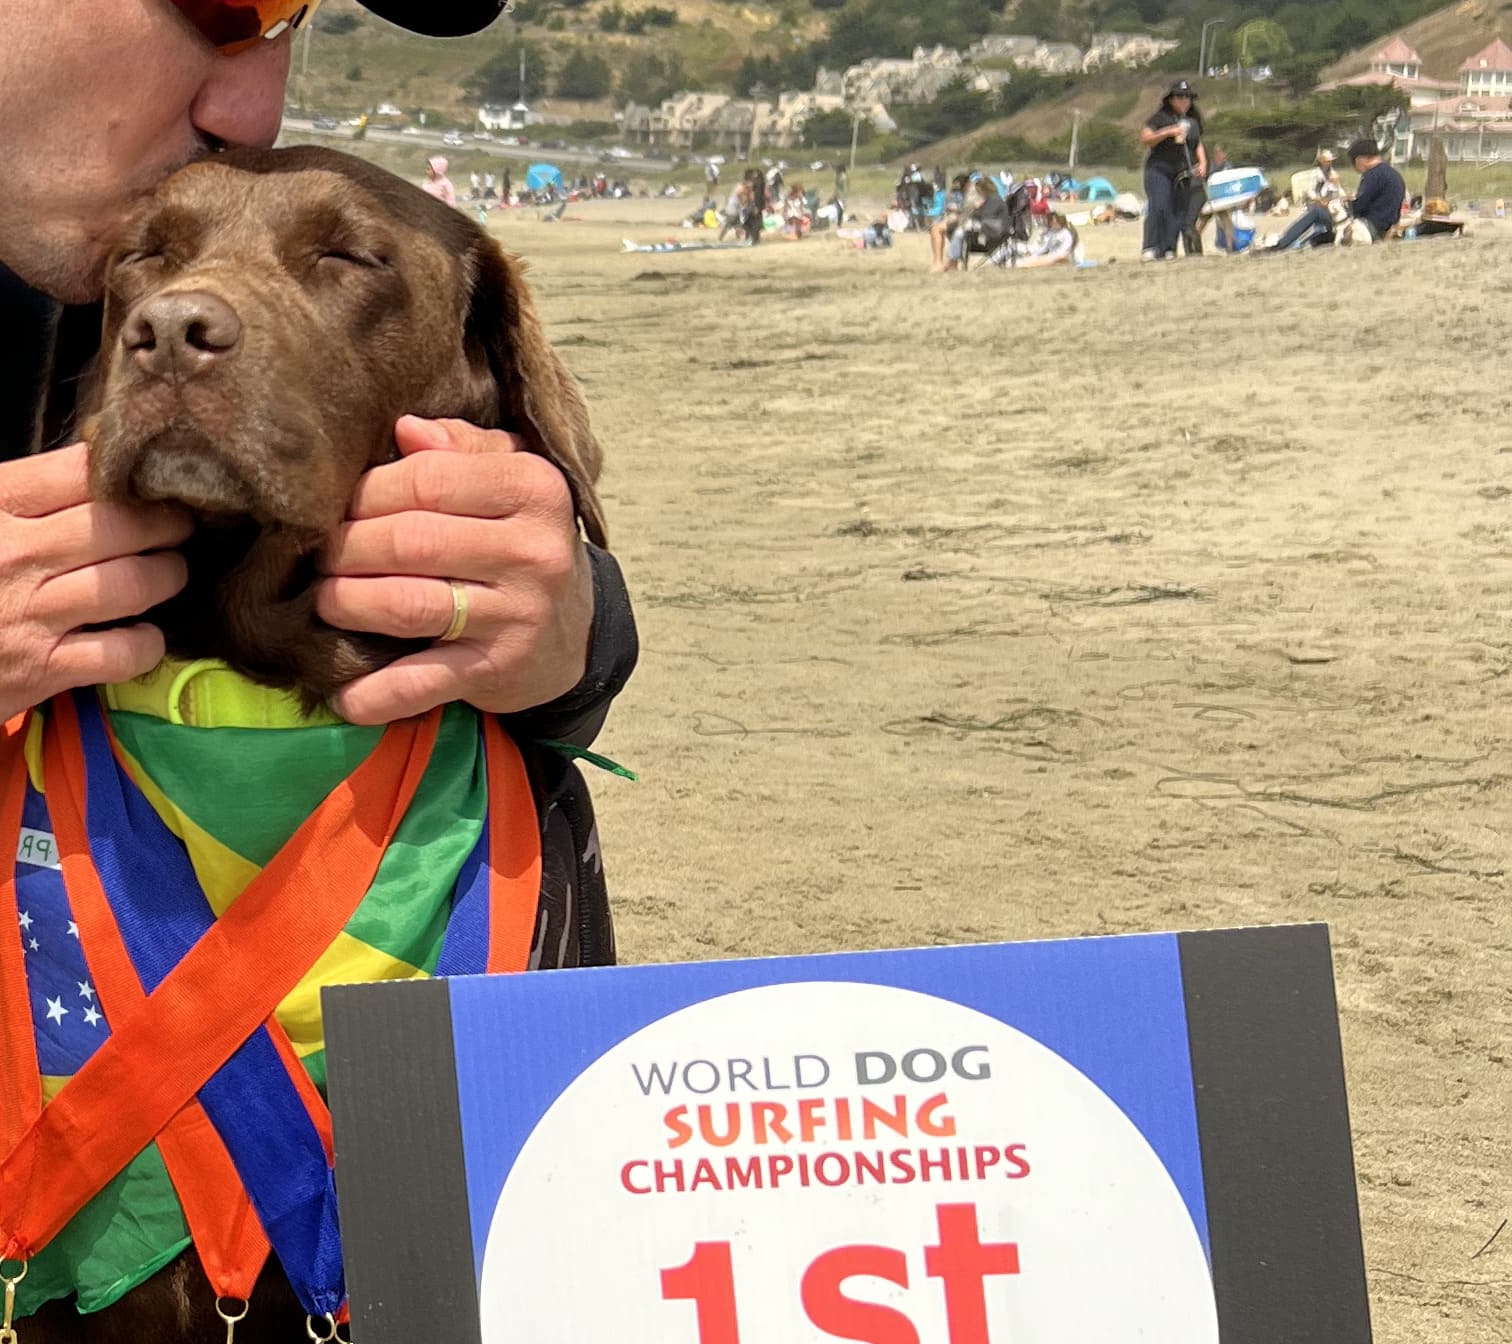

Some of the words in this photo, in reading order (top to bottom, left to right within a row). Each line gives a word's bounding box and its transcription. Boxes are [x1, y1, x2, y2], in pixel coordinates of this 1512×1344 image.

[630, 1054, 830, 1096] WORLD
[854, 1045, 991, 1085] DOG
[663, 1092, 957, 1149] SURFING
[620, 1143, 1031, 1195] CHAMPIONSHIPS
